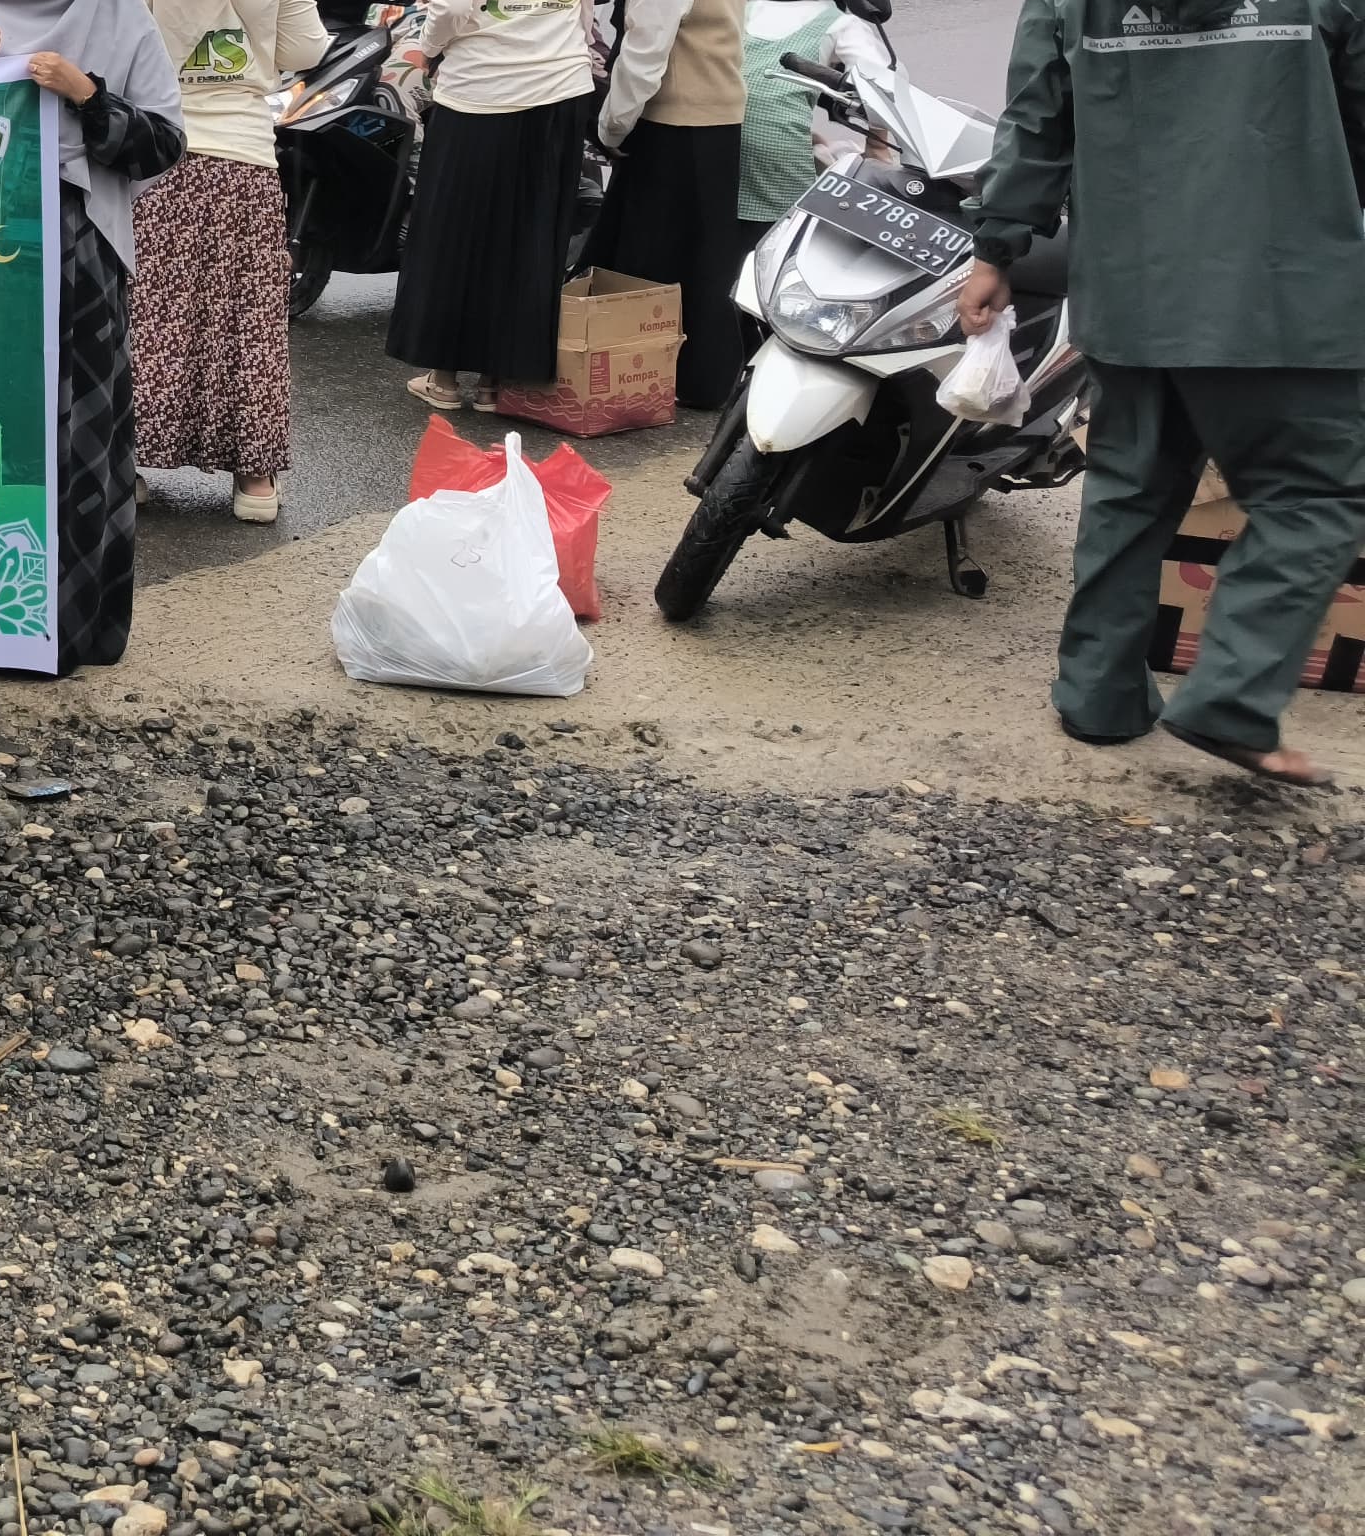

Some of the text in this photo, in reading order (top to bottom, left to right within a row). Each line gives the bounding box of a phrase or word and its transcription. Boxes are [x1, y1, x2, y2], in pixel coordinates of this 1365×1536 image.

[1230, 14, 1259, 25] RAIN
[1123, 23, 1174, 34] PASSION
[817, 174, 852, 199] DD
[856, 193, 920, 231] 2786
[639, 317, 677, 333] Kompas
[618, 368, 659, 385] Kompas
